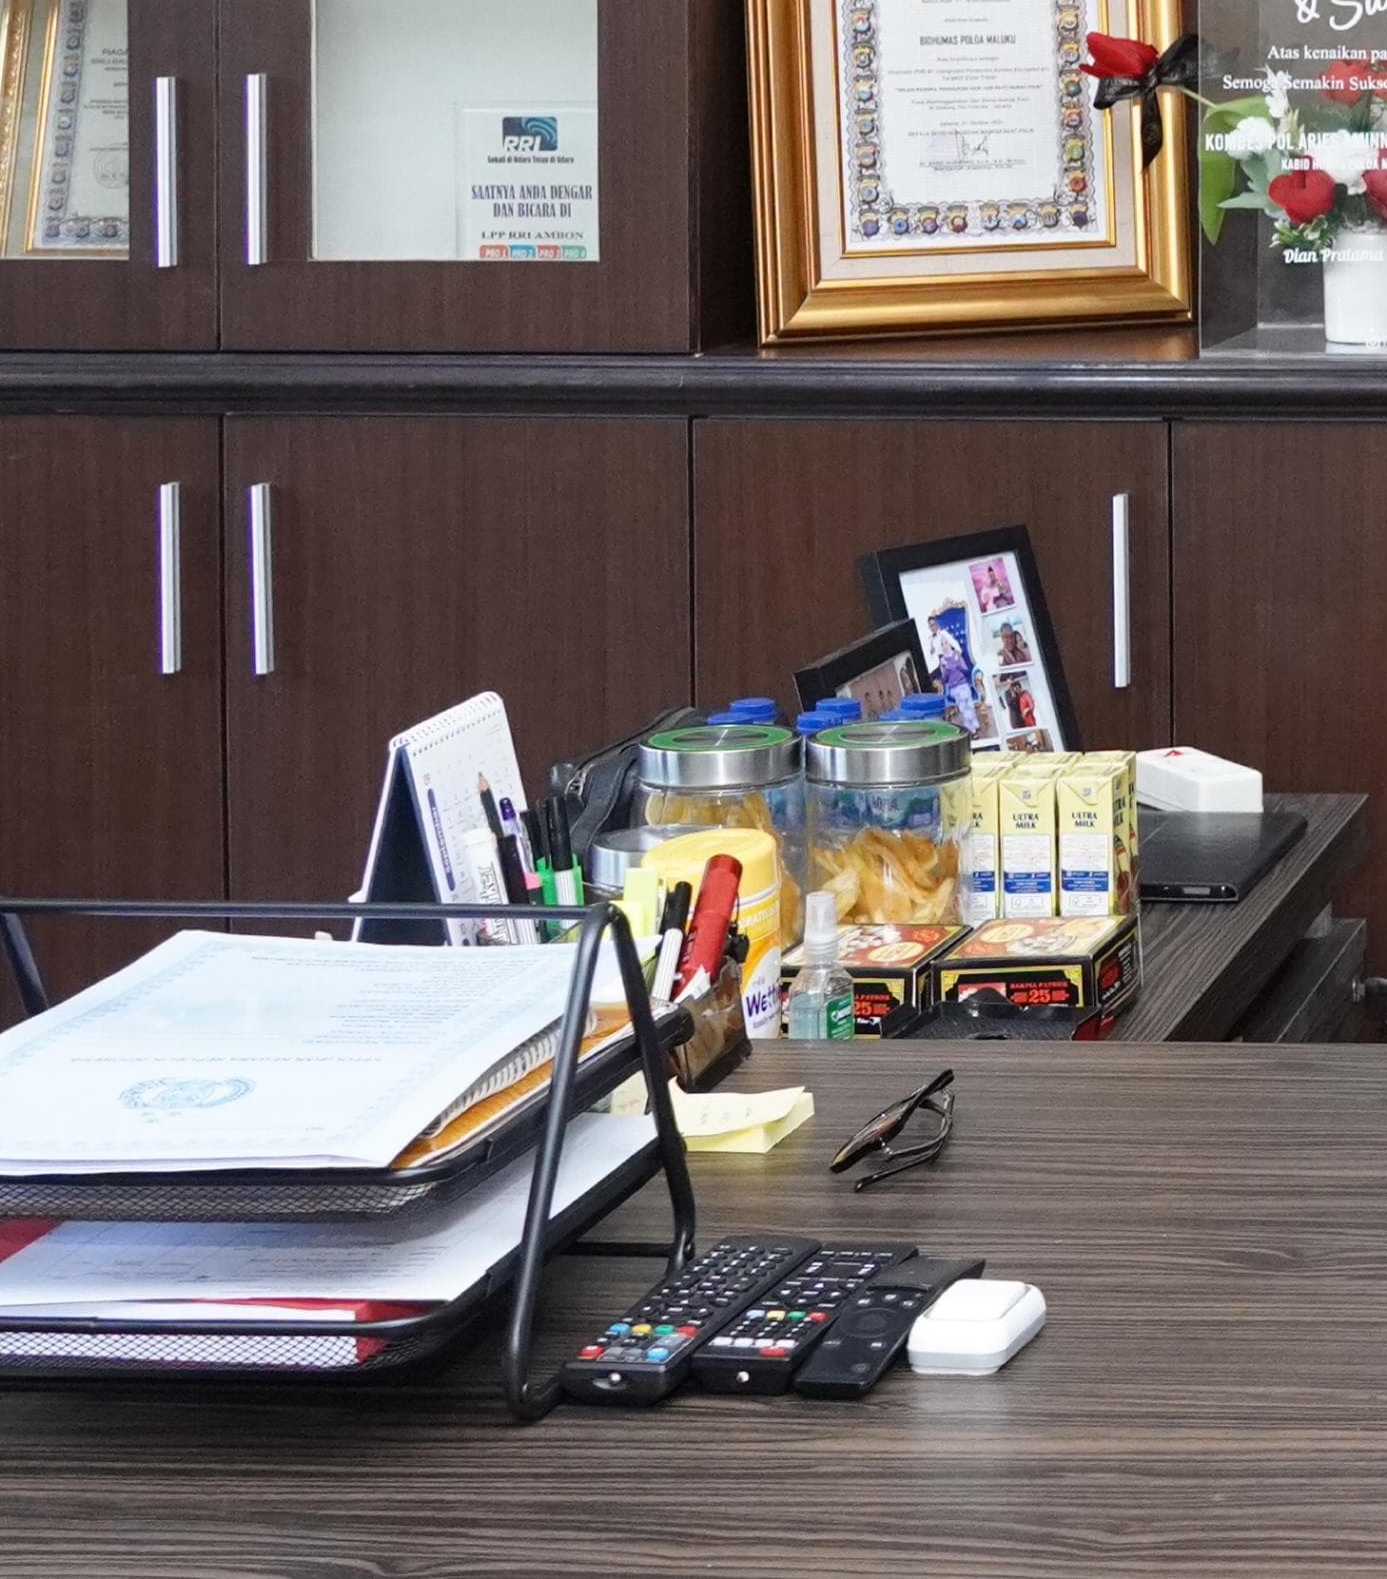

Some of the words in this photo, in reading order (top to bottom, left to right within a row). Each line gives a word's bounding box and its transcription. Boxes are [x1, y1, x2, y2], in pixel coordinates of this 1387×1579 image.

[920, 35, 957, 46] BIDHUMAS
[960, 35, 984, 45] POLDA
[987, 35, 1016, 44] MALUKU
[1267, 45, 1299, 60] Atas
[1303, 45, 1367, 60] kenaikan
[1223, 75, 1277, 92] Semog
[1285, 74, 1344, 90] Semakin
[504, 135, 542, 152] RRI
[1268, 133, 1293, 150] POL
[1281, 158, 1310, 170] KABID
[472, 185, 515, 200] SAATNYA
[519, 185, 547, 200] ANDA
[550, 185, 592, 200] DENGAR
[493, 202, 514, 217] DAN
[518, 202, 556, 218] BICARA
[560, 202, 571, 218] DI
[508, 230, 531, 239] RRI
[534, 230, 584, 239] AMBON
[1013, 813, 1039, 821] ULTRA
[1072, 812, 1097, 820] ULTRA
[1075, 820, 1095, 828] MILK
[1028, 989, 1051, 1004] 25
